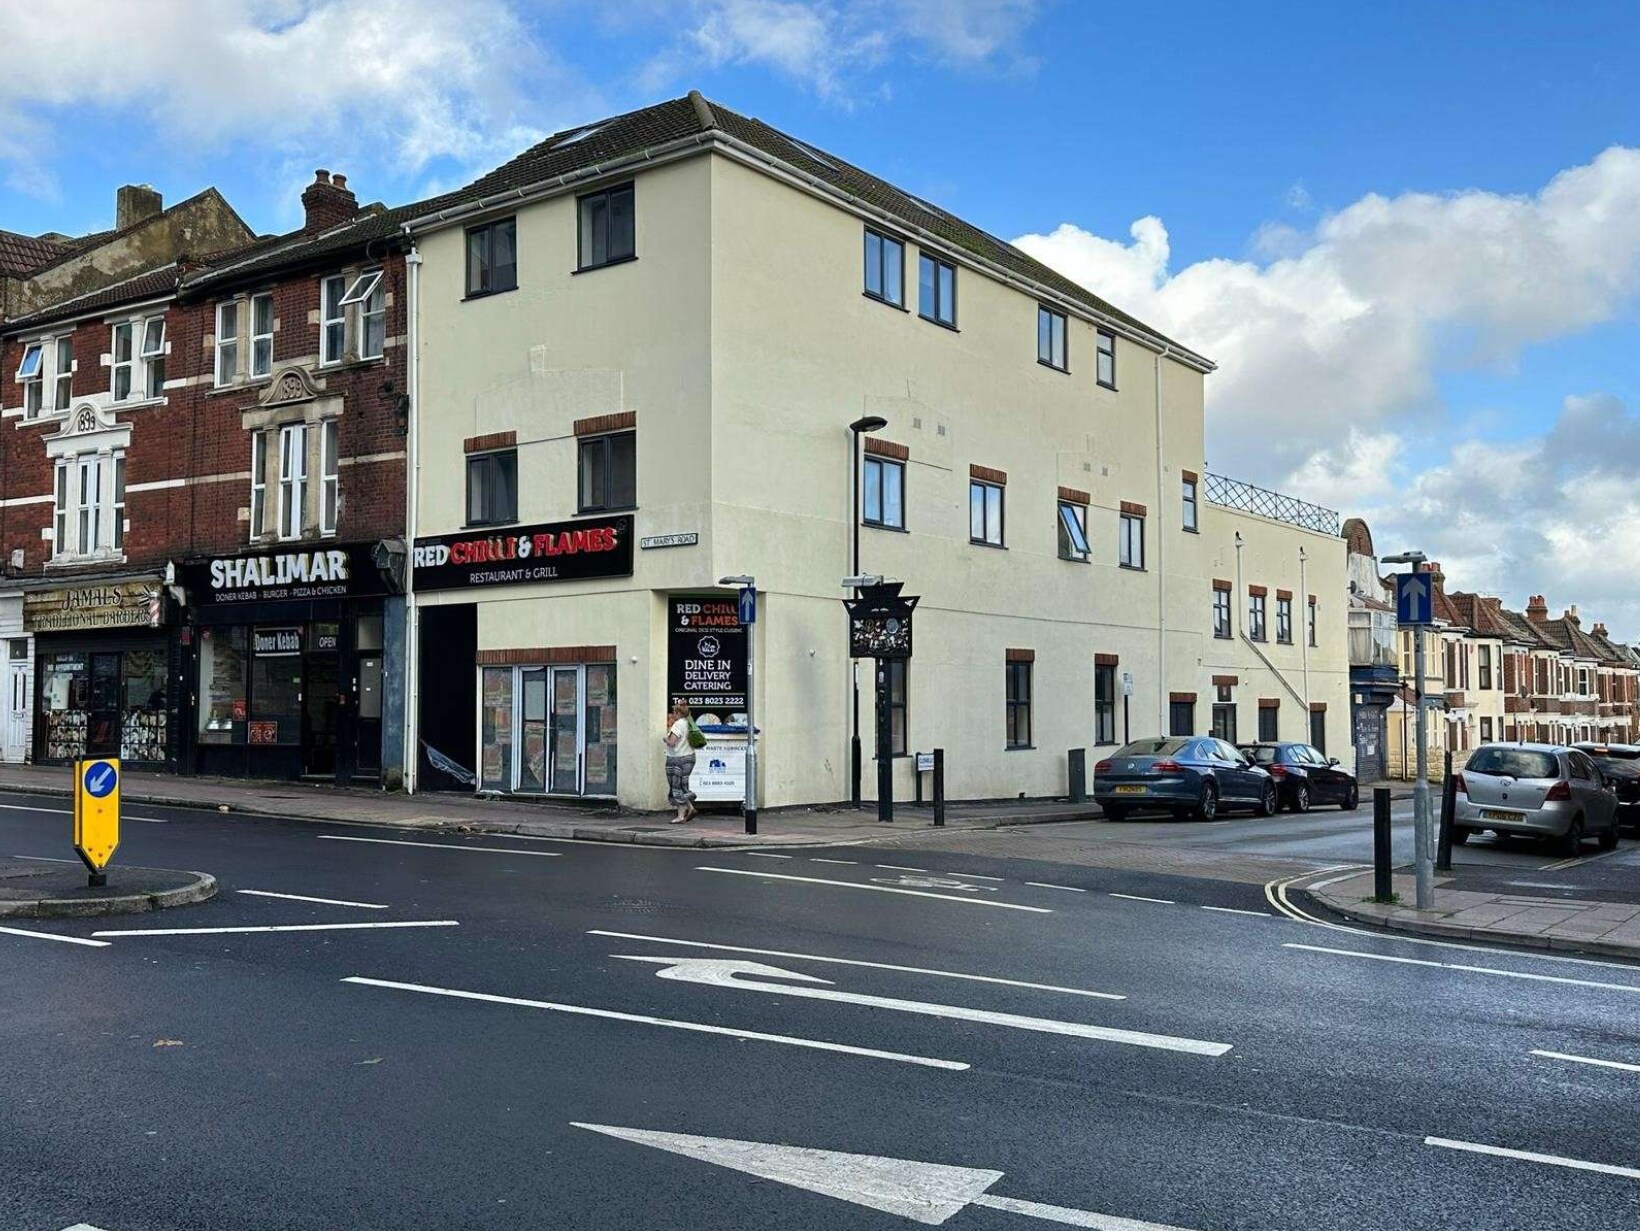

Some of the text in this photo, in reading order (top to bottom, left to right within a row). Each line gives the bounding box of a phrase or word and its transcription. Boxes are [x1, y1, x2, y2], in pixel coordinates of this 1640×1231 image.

[281, 376, 302, 400] 1899
[77, 410, 96, 432] 1899
[678, 535, 695, 543] ROAD
[413, 543, 449, 568] RED
[518, 535, 532, 559] &
[532, 526, 620, 557] FLAMES
[210, 550, 349, 589] SHALIMAR
[469, 566, 559, 584] RESTAURANT & GRILL
[61, 587, 122, 611] JAMALS
[216, 592, 237, 602] DONER
[238, 591, 257, 600] KEBAB
[263, 589, 288, 599] BURGER
[293, 587, 311, 597] PIZZA
[316, 585, 347, 595] CHICKEN
[676, 603, 738, 614] RED CHILL
[681, 614, 738, 626] & FLAMES
[254, 631, 300, 651] Doner Kebab
[318, 636, 337, 648] OPEN
[685, 660, 732, 670] DINE IN
[684, 671, 732, 680] DELIVERY
[683, 681, 732, 690] CATERING
[688, 697, 704, 705] 023
[704, 697, 723, 705] 8023
[724, 697, 744, 705] 2222
